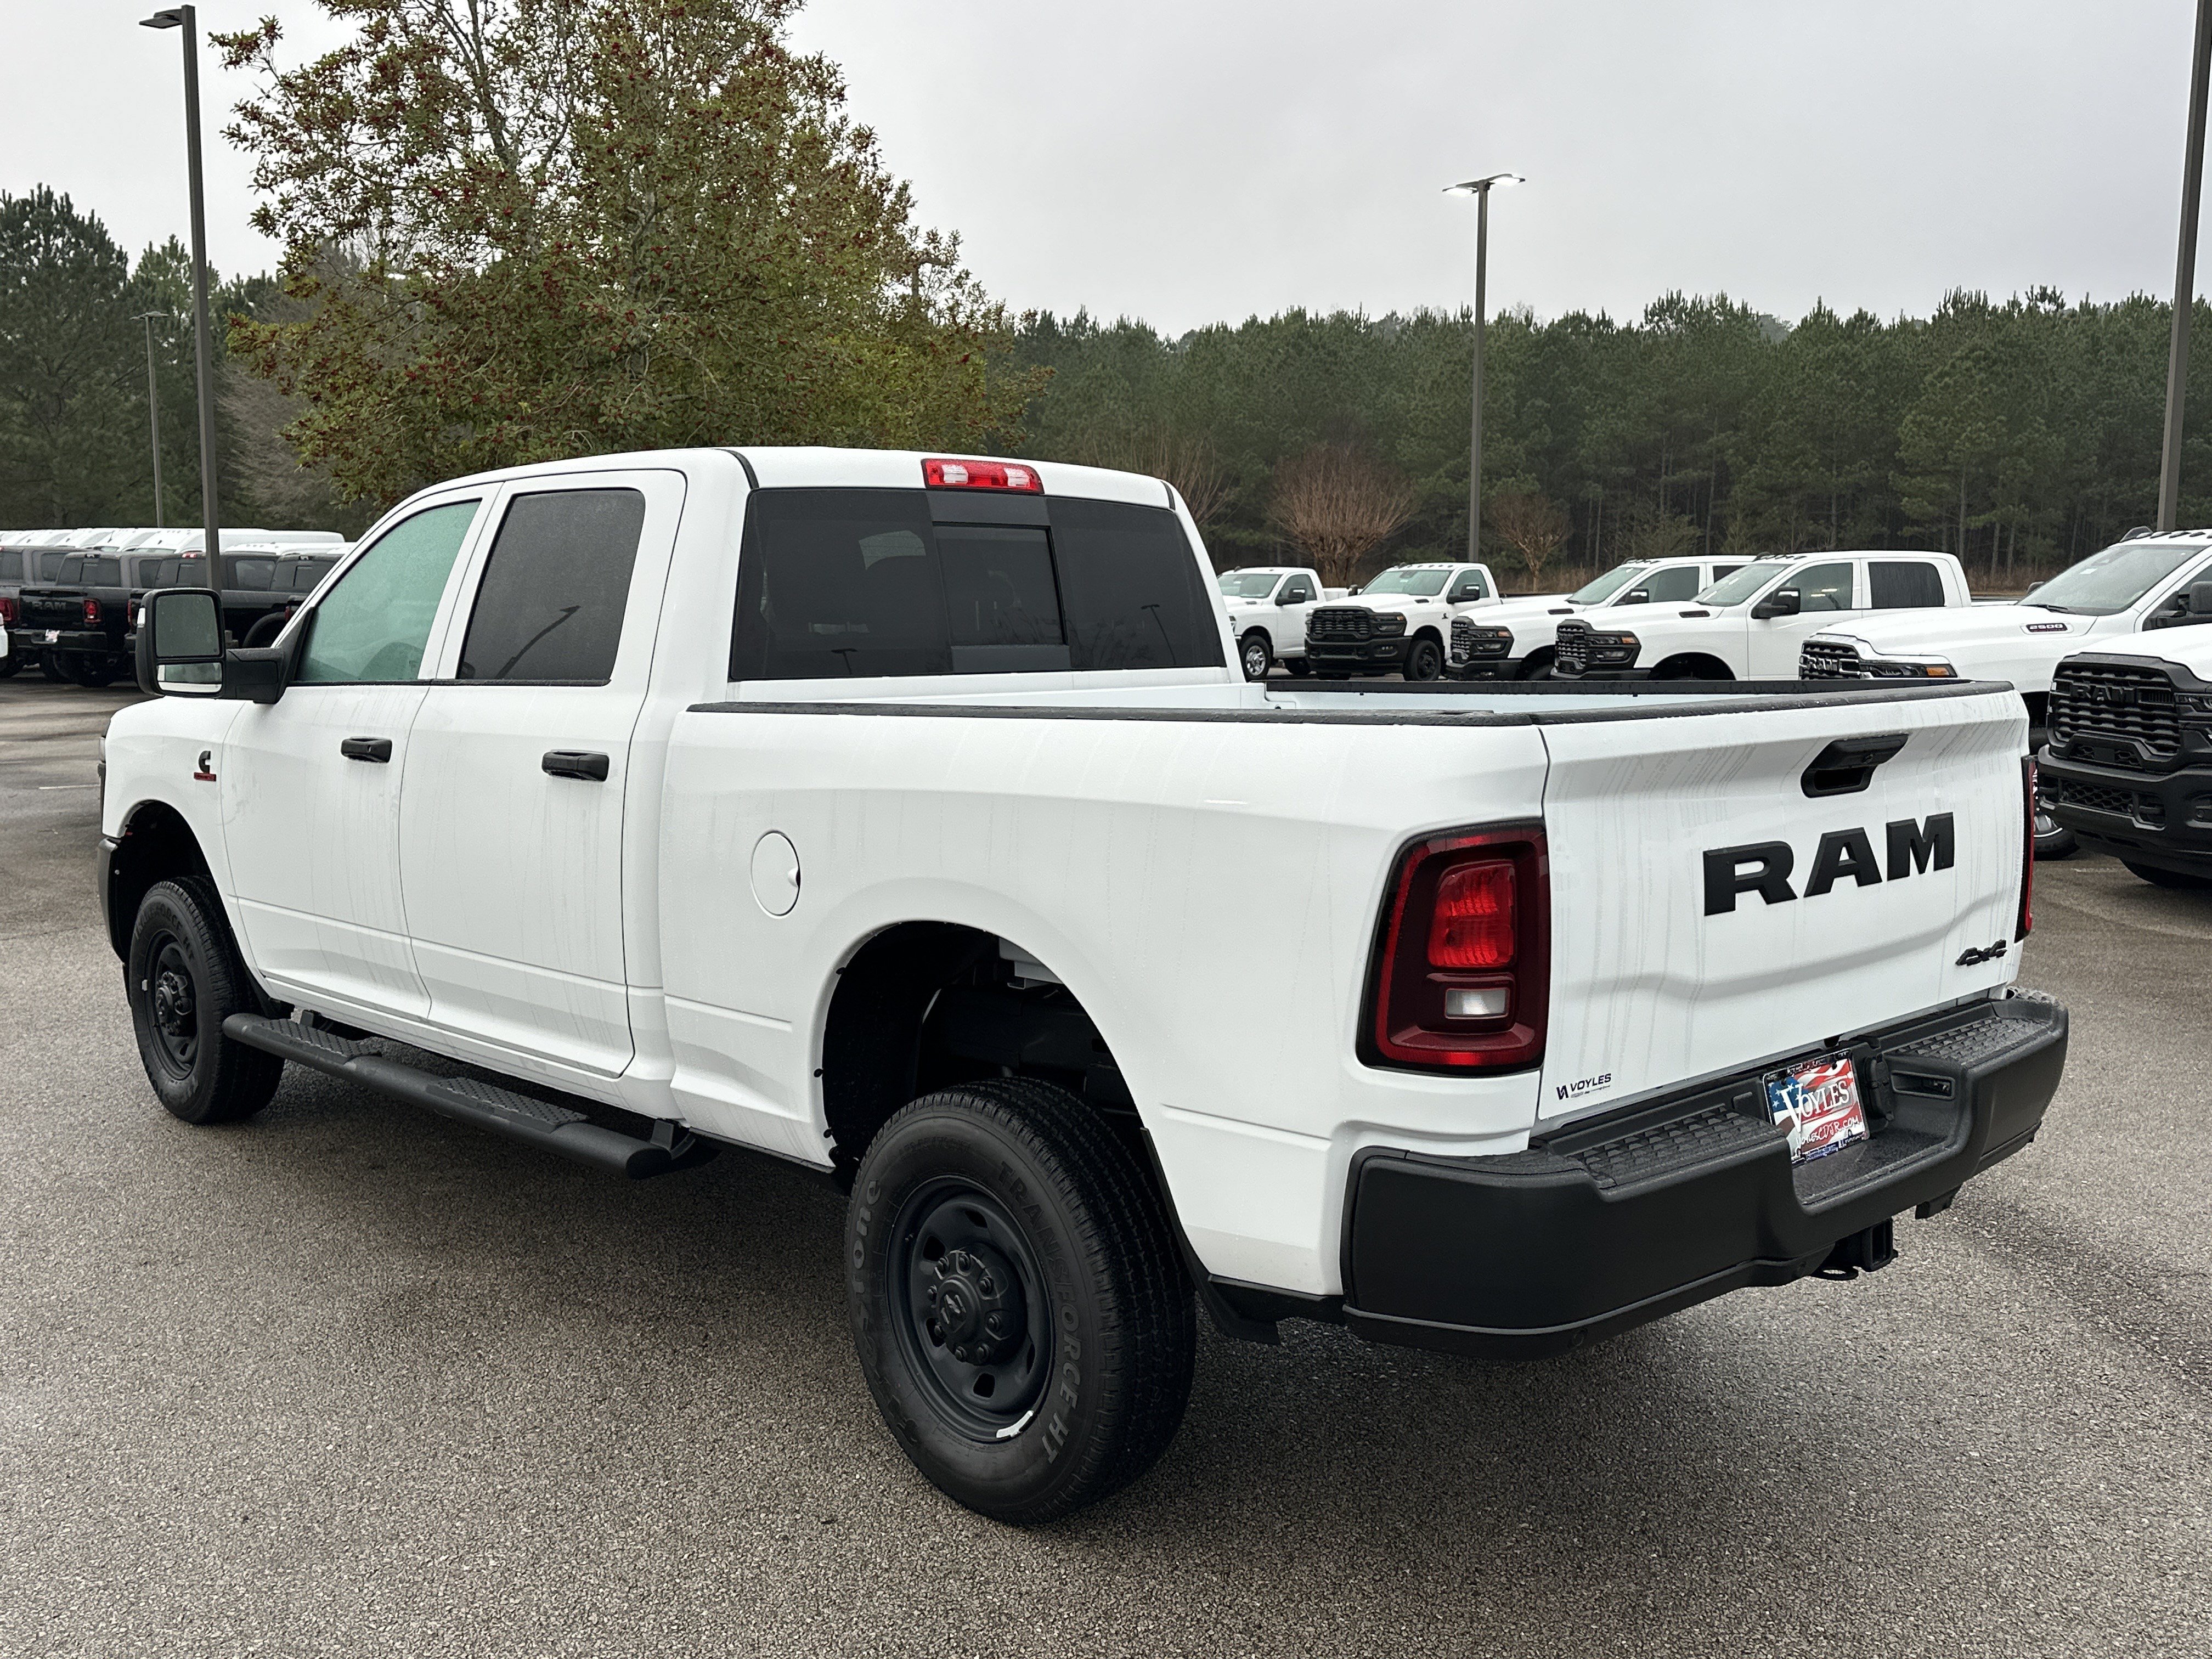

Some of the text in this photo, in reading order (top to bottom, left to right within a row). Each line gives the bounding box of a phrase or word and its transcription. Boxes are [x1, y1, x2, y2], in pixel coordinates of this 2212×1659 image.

[32, 601, 66, 610] RAM
[2071, 682, 2135, 703] RAM
[1702, 811, 1955, 916] RAM
[1570, 1073, 1612, 1092] VOYLES
[1780, 1080, 1850, 1135] VOYLES
[998, 1160, 1082, 1464] TRANSFORCE HT
